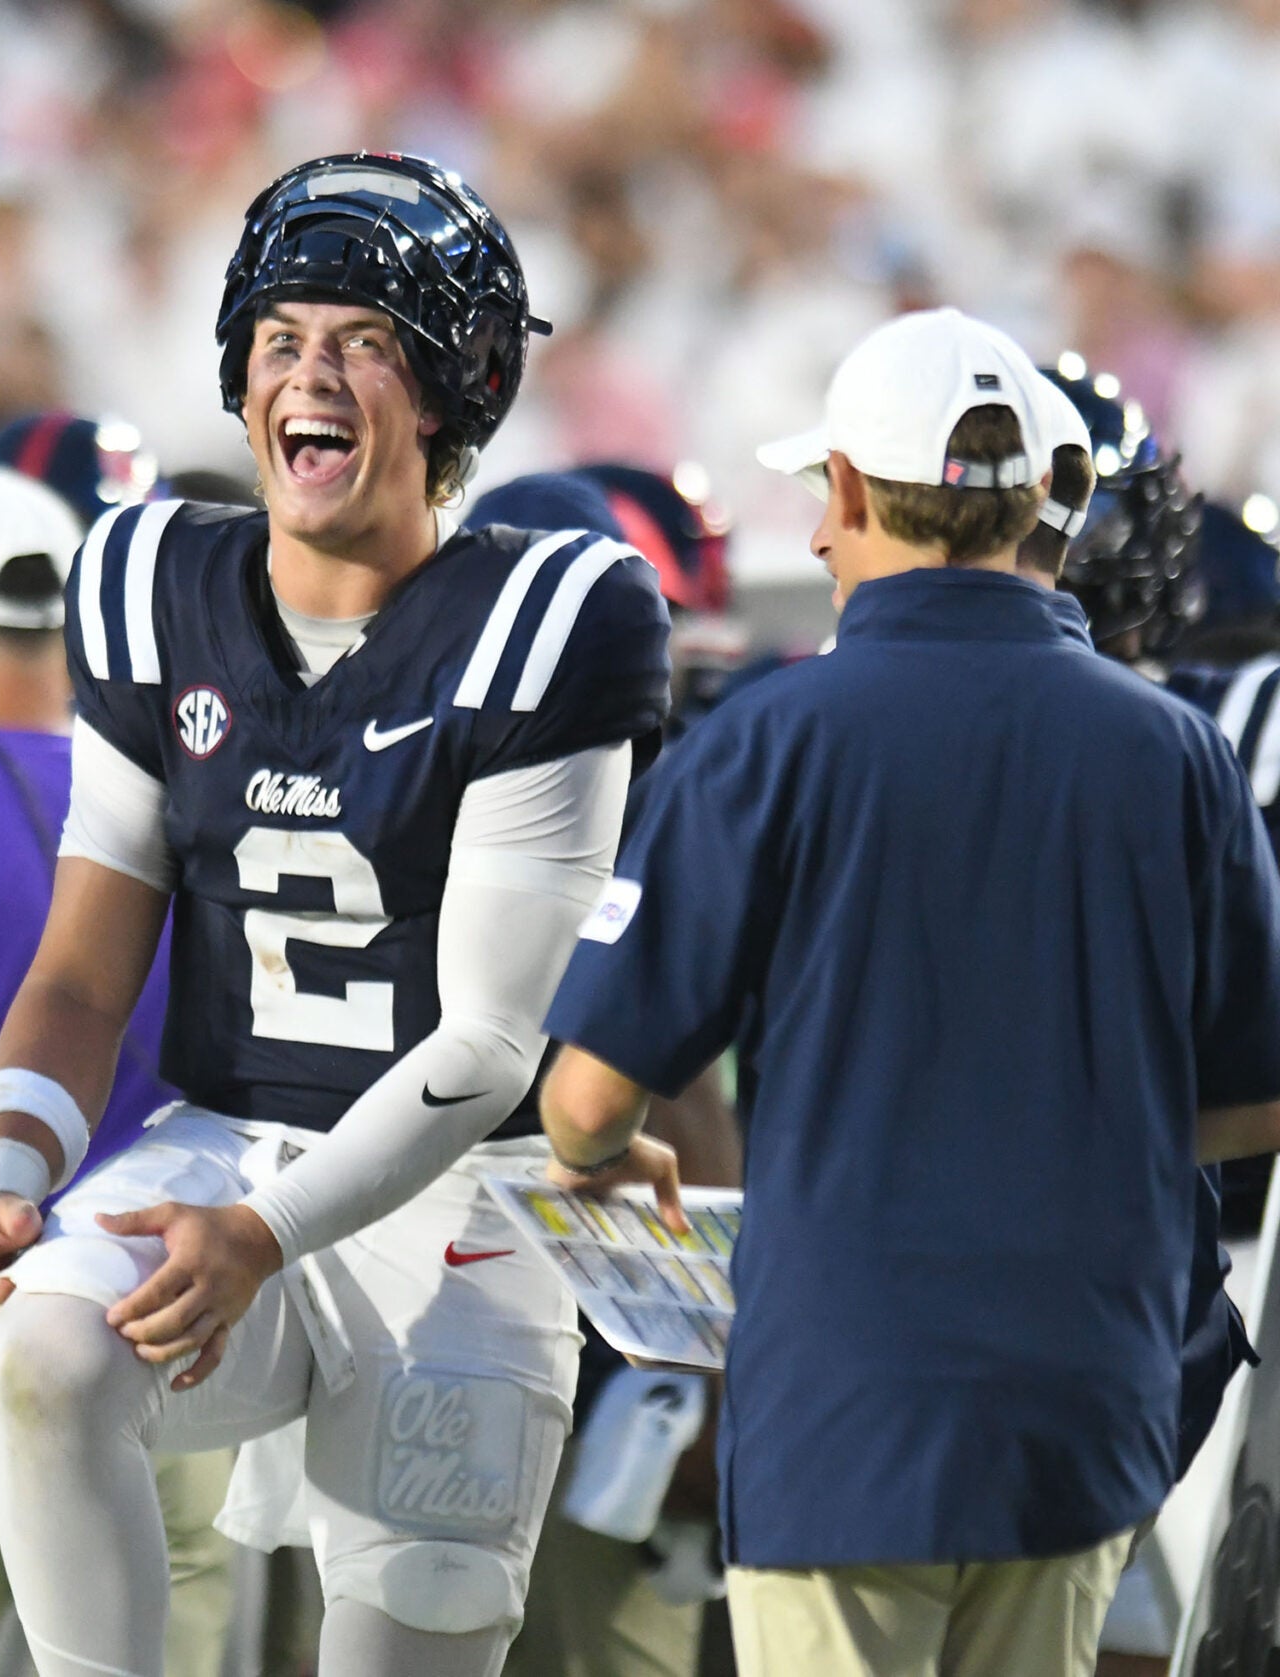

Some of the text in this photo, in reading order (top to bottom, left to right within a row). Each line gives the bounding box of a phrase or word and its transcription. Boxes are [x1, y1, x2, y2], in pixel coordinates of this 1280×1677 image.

[177, 689, 227, 755] SEC
[233, 826, 395, 1052] 2
[390, 1377, 469, 1448] Ole
[388, 1448, 511, 1519] Miss
